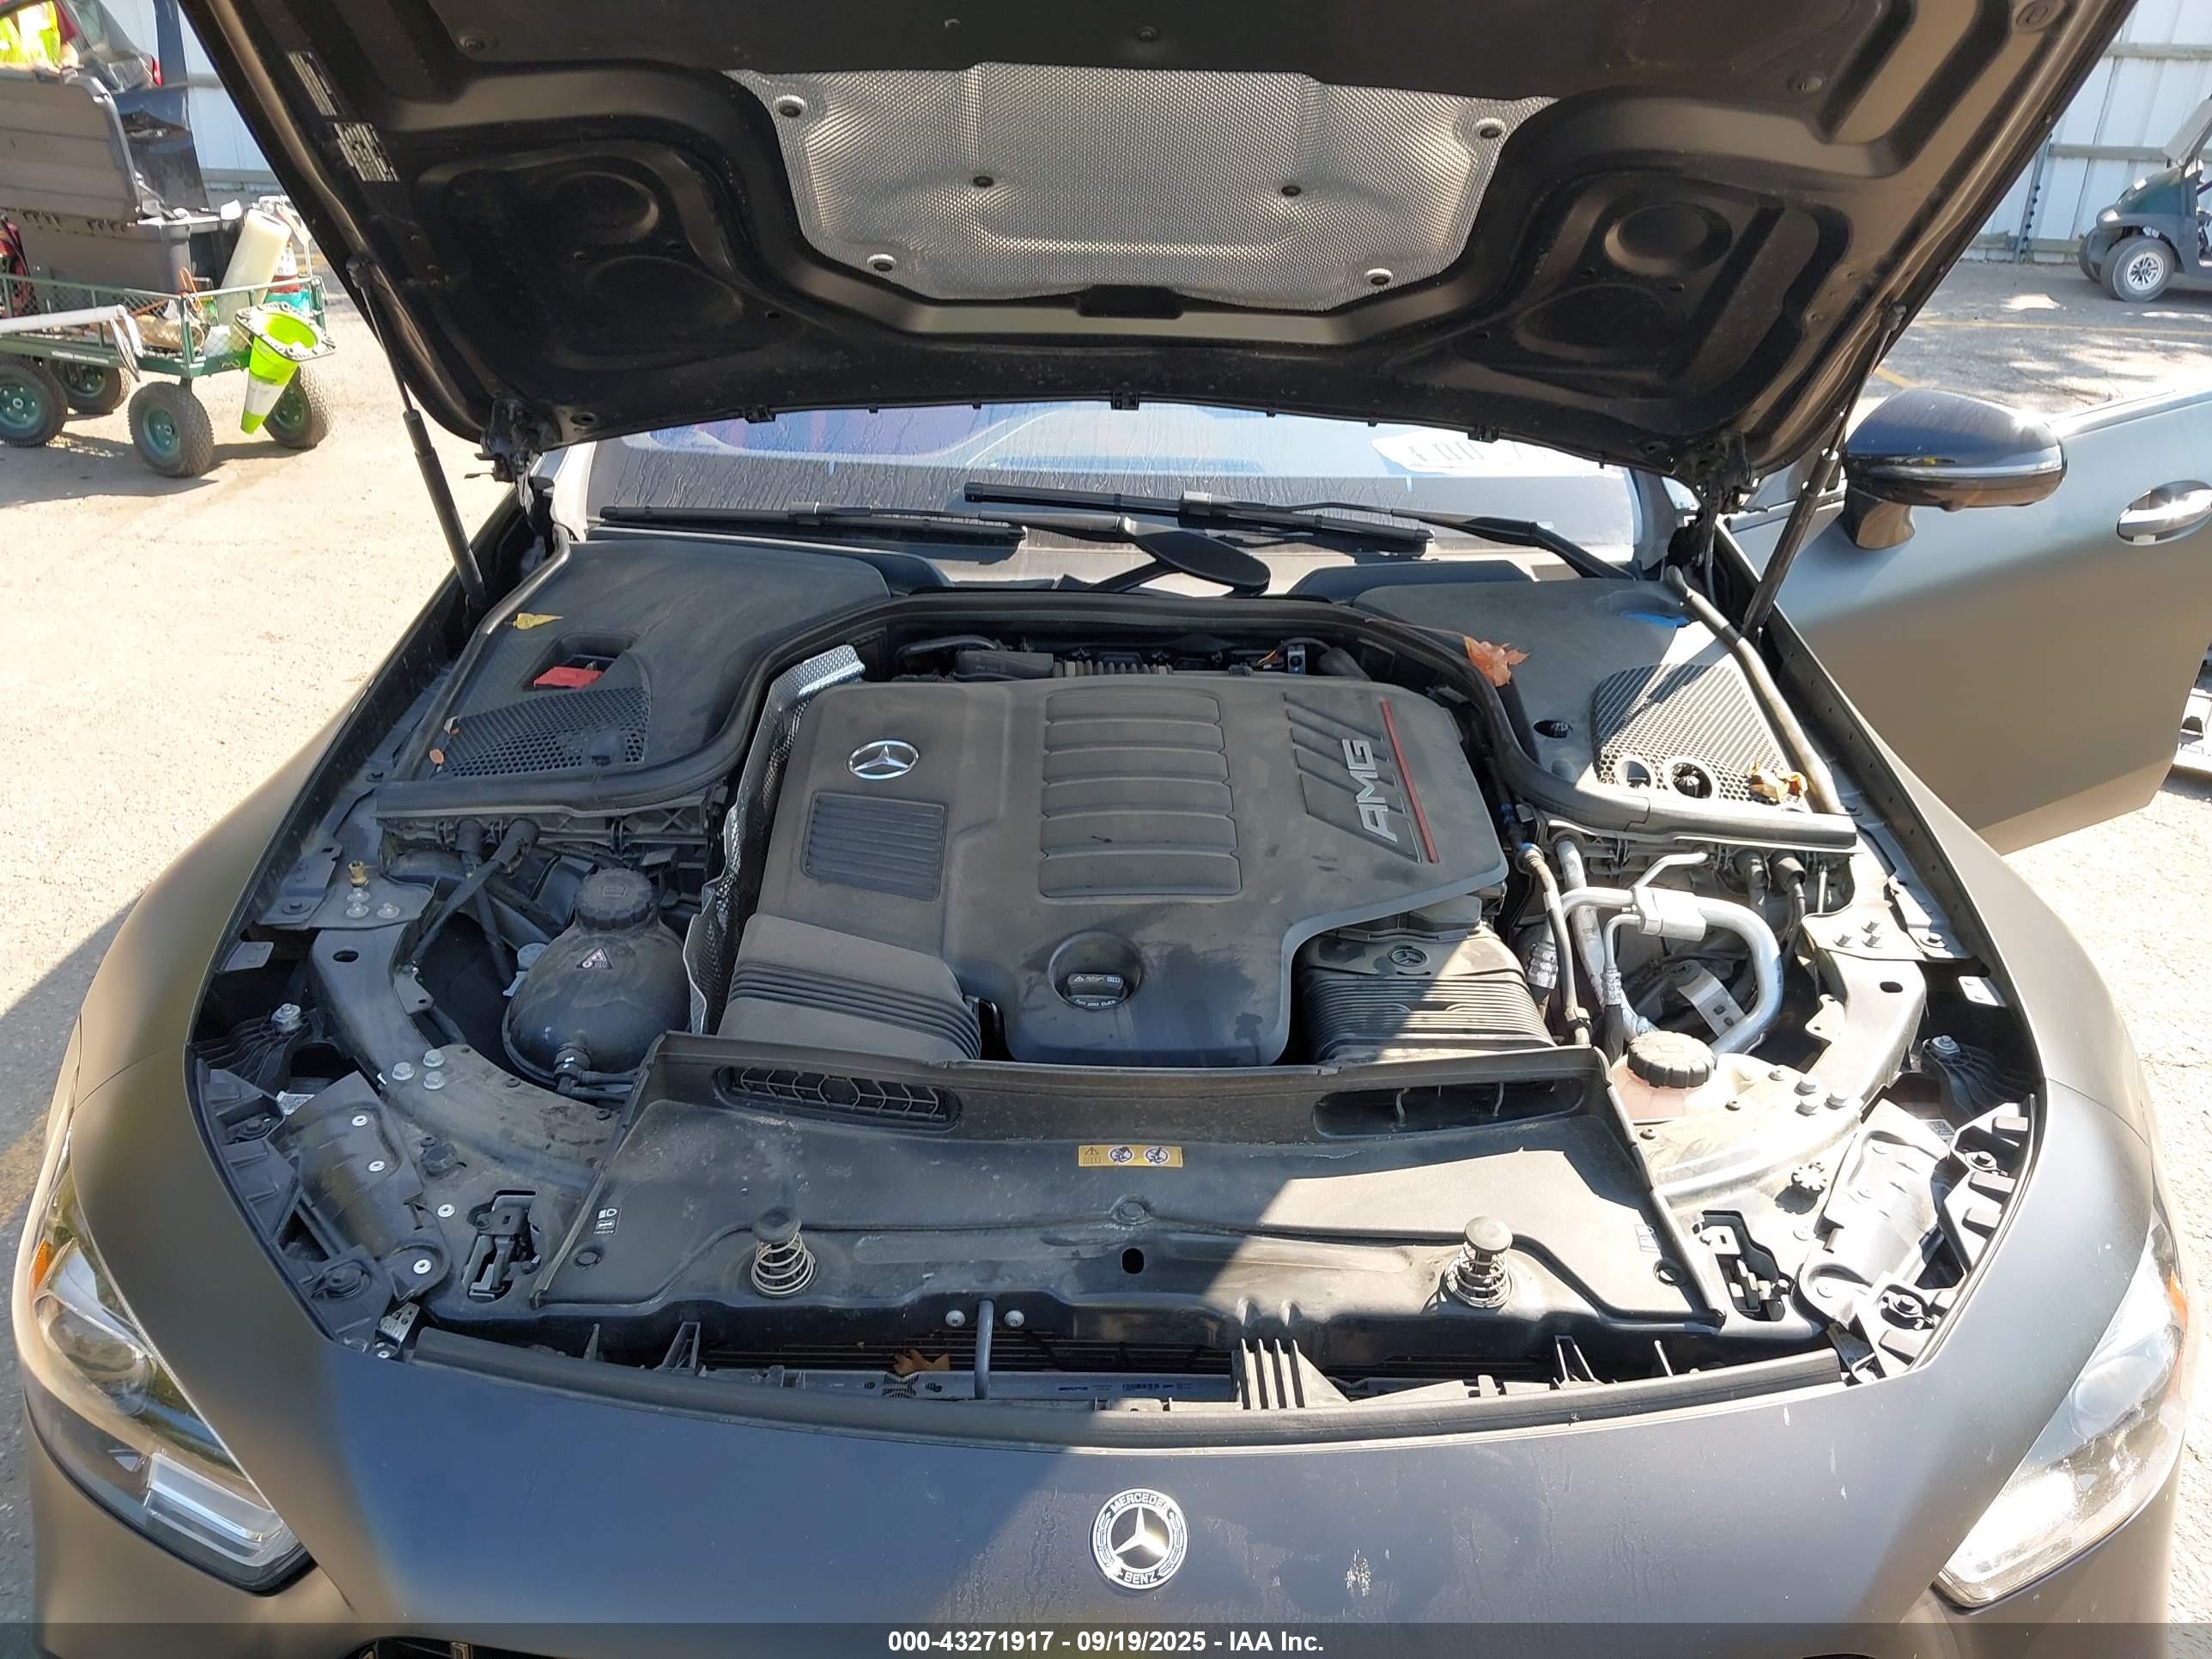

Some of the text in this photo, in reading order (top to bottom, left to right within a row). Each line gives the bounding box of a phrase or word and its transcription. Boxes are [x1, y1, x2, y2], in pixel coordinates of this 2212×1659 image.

[1341, 738, 1398, 842] AMG
[1109, 1492, 1170, 1514] MERCEDES
[1123, 1571, 1158, 1584] BENZ
